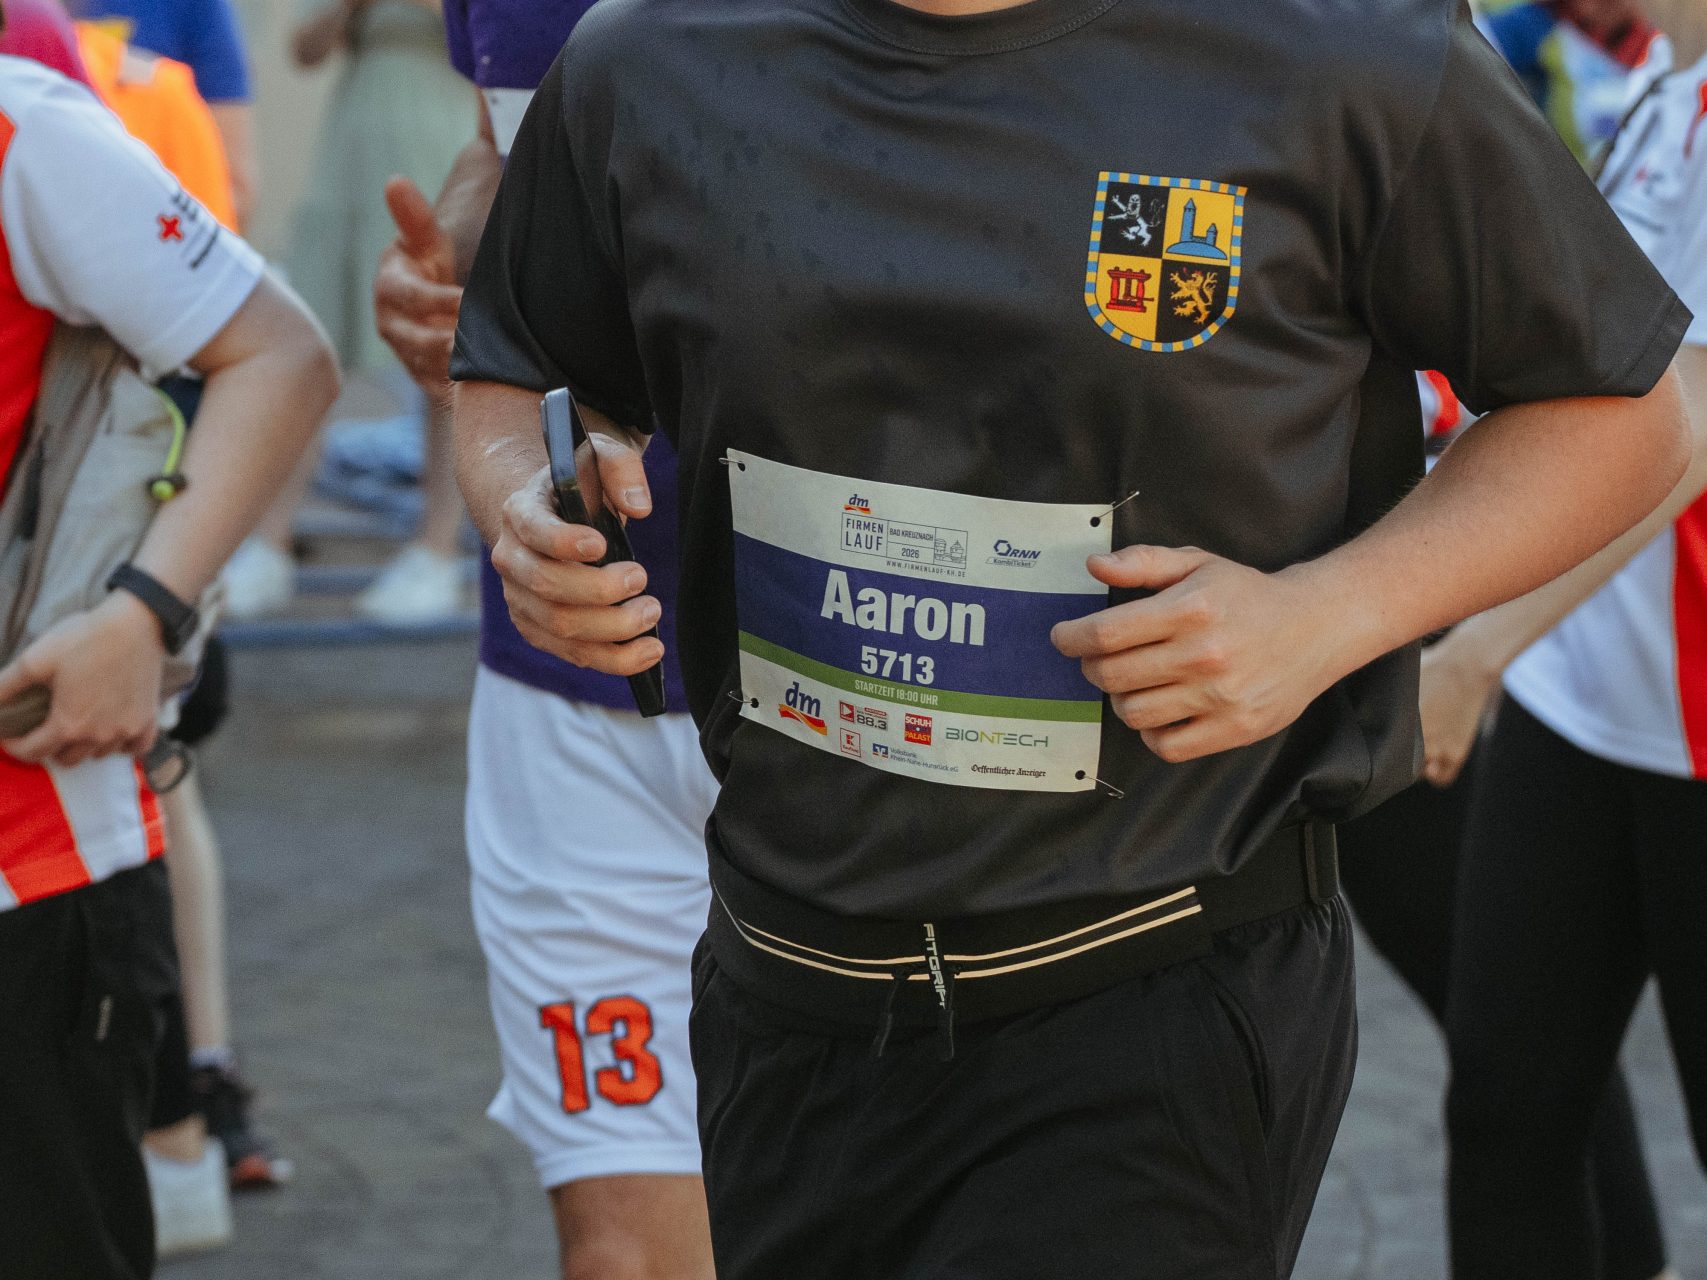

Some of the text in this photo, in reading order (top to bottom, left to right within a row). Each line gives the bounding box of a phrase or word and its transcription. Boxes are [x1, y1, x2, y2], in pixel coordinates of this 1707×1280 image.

[848, 494, 869, 507] dm
[846, 518, 884, 534] FIRMEN
[889, 527, 934, 541] BAD KREUZNACH
[845, 531, 884, 551] LAUF
[901, 548, 920, 559] 2026
[886, 561, 966, 578] WWW.FIRMENLAUF-KH.DE
[820, 568, 986, 646] Aaron
[860, 645, 935, 685] 5713
[785, 681, 821, 718] dm
[854, 679, 938, 706] STARTZEIT 18:00 UHR
[856, 714, 887, 730] 88.3
[905, 716, 932, 727] SCHUH
[904, 731, 931, 743] PALAST
[945, 727, 1049, 747] BIONTECH
[890, 748, 918, 758] Volksbank
[538, 995, 664, 1114] 13
